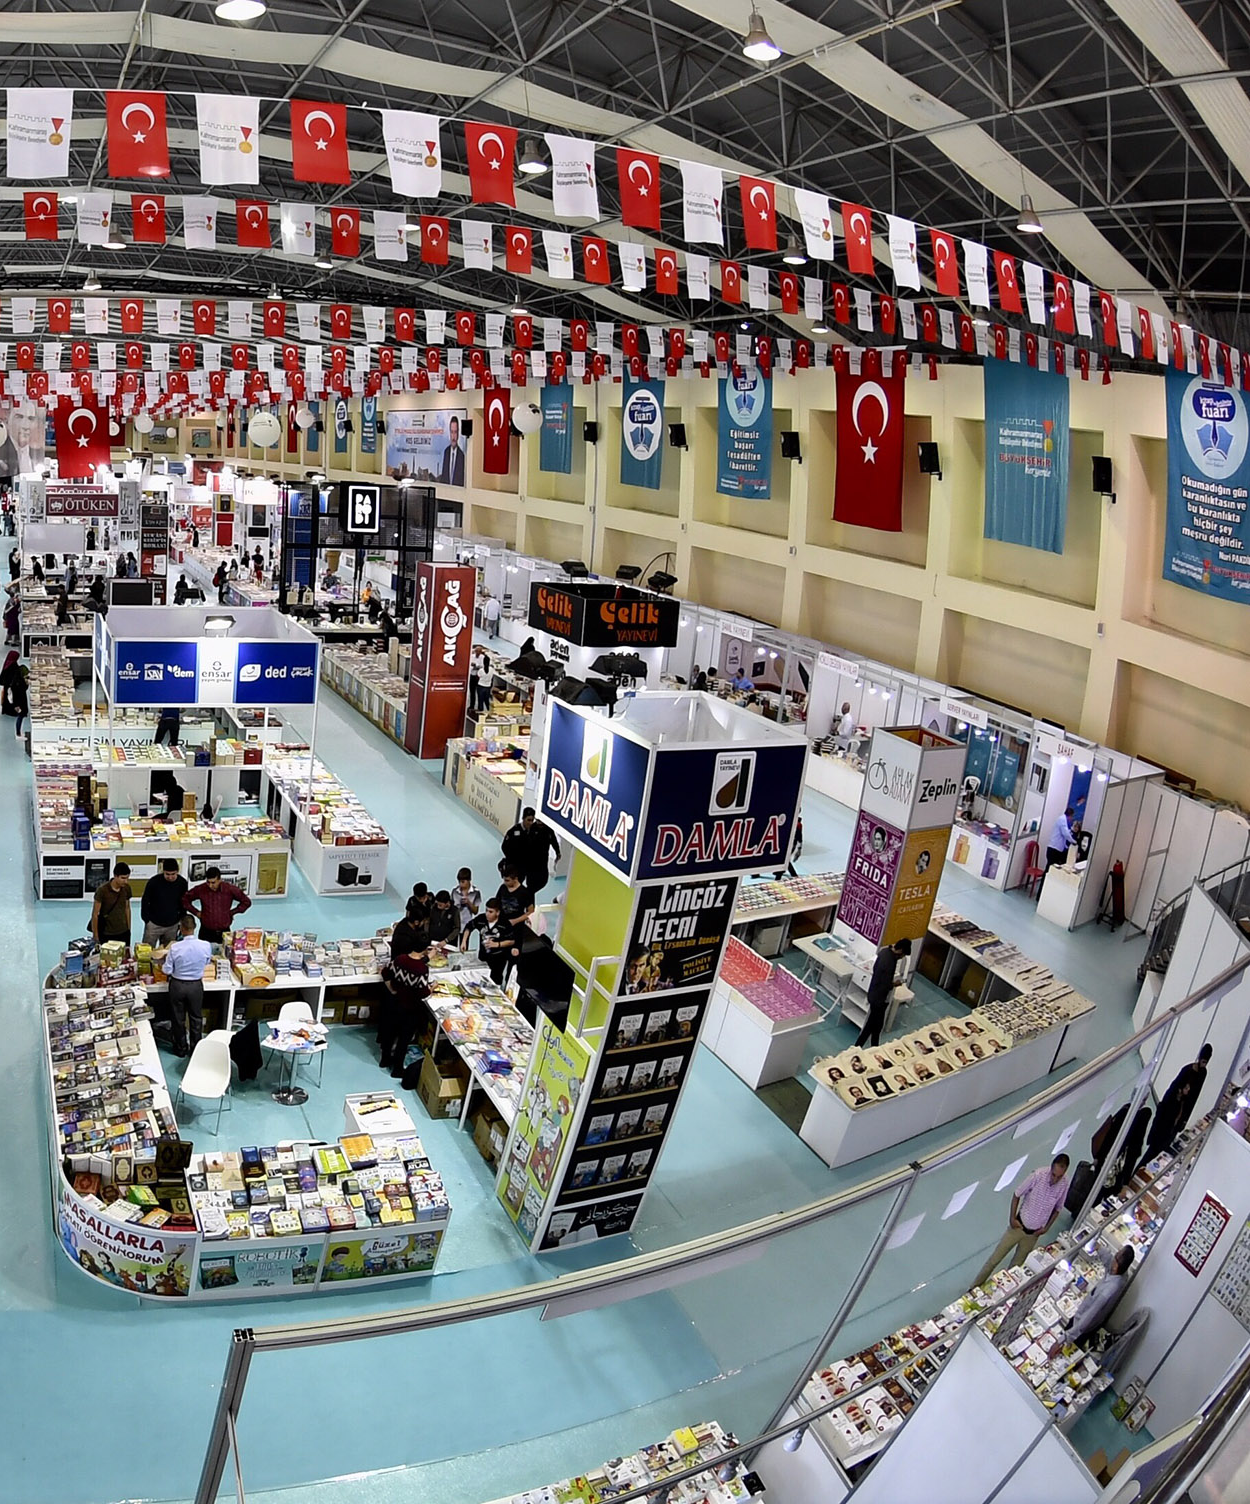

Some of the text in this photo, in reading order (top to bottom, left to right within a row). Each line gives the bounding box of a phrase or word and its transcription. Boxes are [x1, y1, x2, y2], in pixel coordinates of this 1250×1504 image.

[1202, 406, 1230, 419] fuarı
[1181, 475, 1249, 499] Okumadığın gün
[65, 497, 115, 511] ÖTÜKEN
[1182, 489, 1236, 509] karanlıktasın
[1198, 504, 1241, 523] karanlıkta
[1193, 517, 1233, 536] hiçbir şey
[1182, 527, 1245, 550] meşru değildir.
[537, 587, 573, 619] Çelik
[600, 601, 659, 630] Çelik
[616, 628, 659, 642] YAYINEVİ
[176, 667, 194, 678] dem
[265, 666, 286, 678] ded
[918, 778, 957, 803] Zeplin
[547, 767, 634, 861] DAMLA
[650, 815, 780, 867] DAMLA
[854, 857, 888, 889] FRIDA
[899, 885, 932, 901] TESLA
[84, 1227, 163, 1265] ÖĞRENİYORUM
